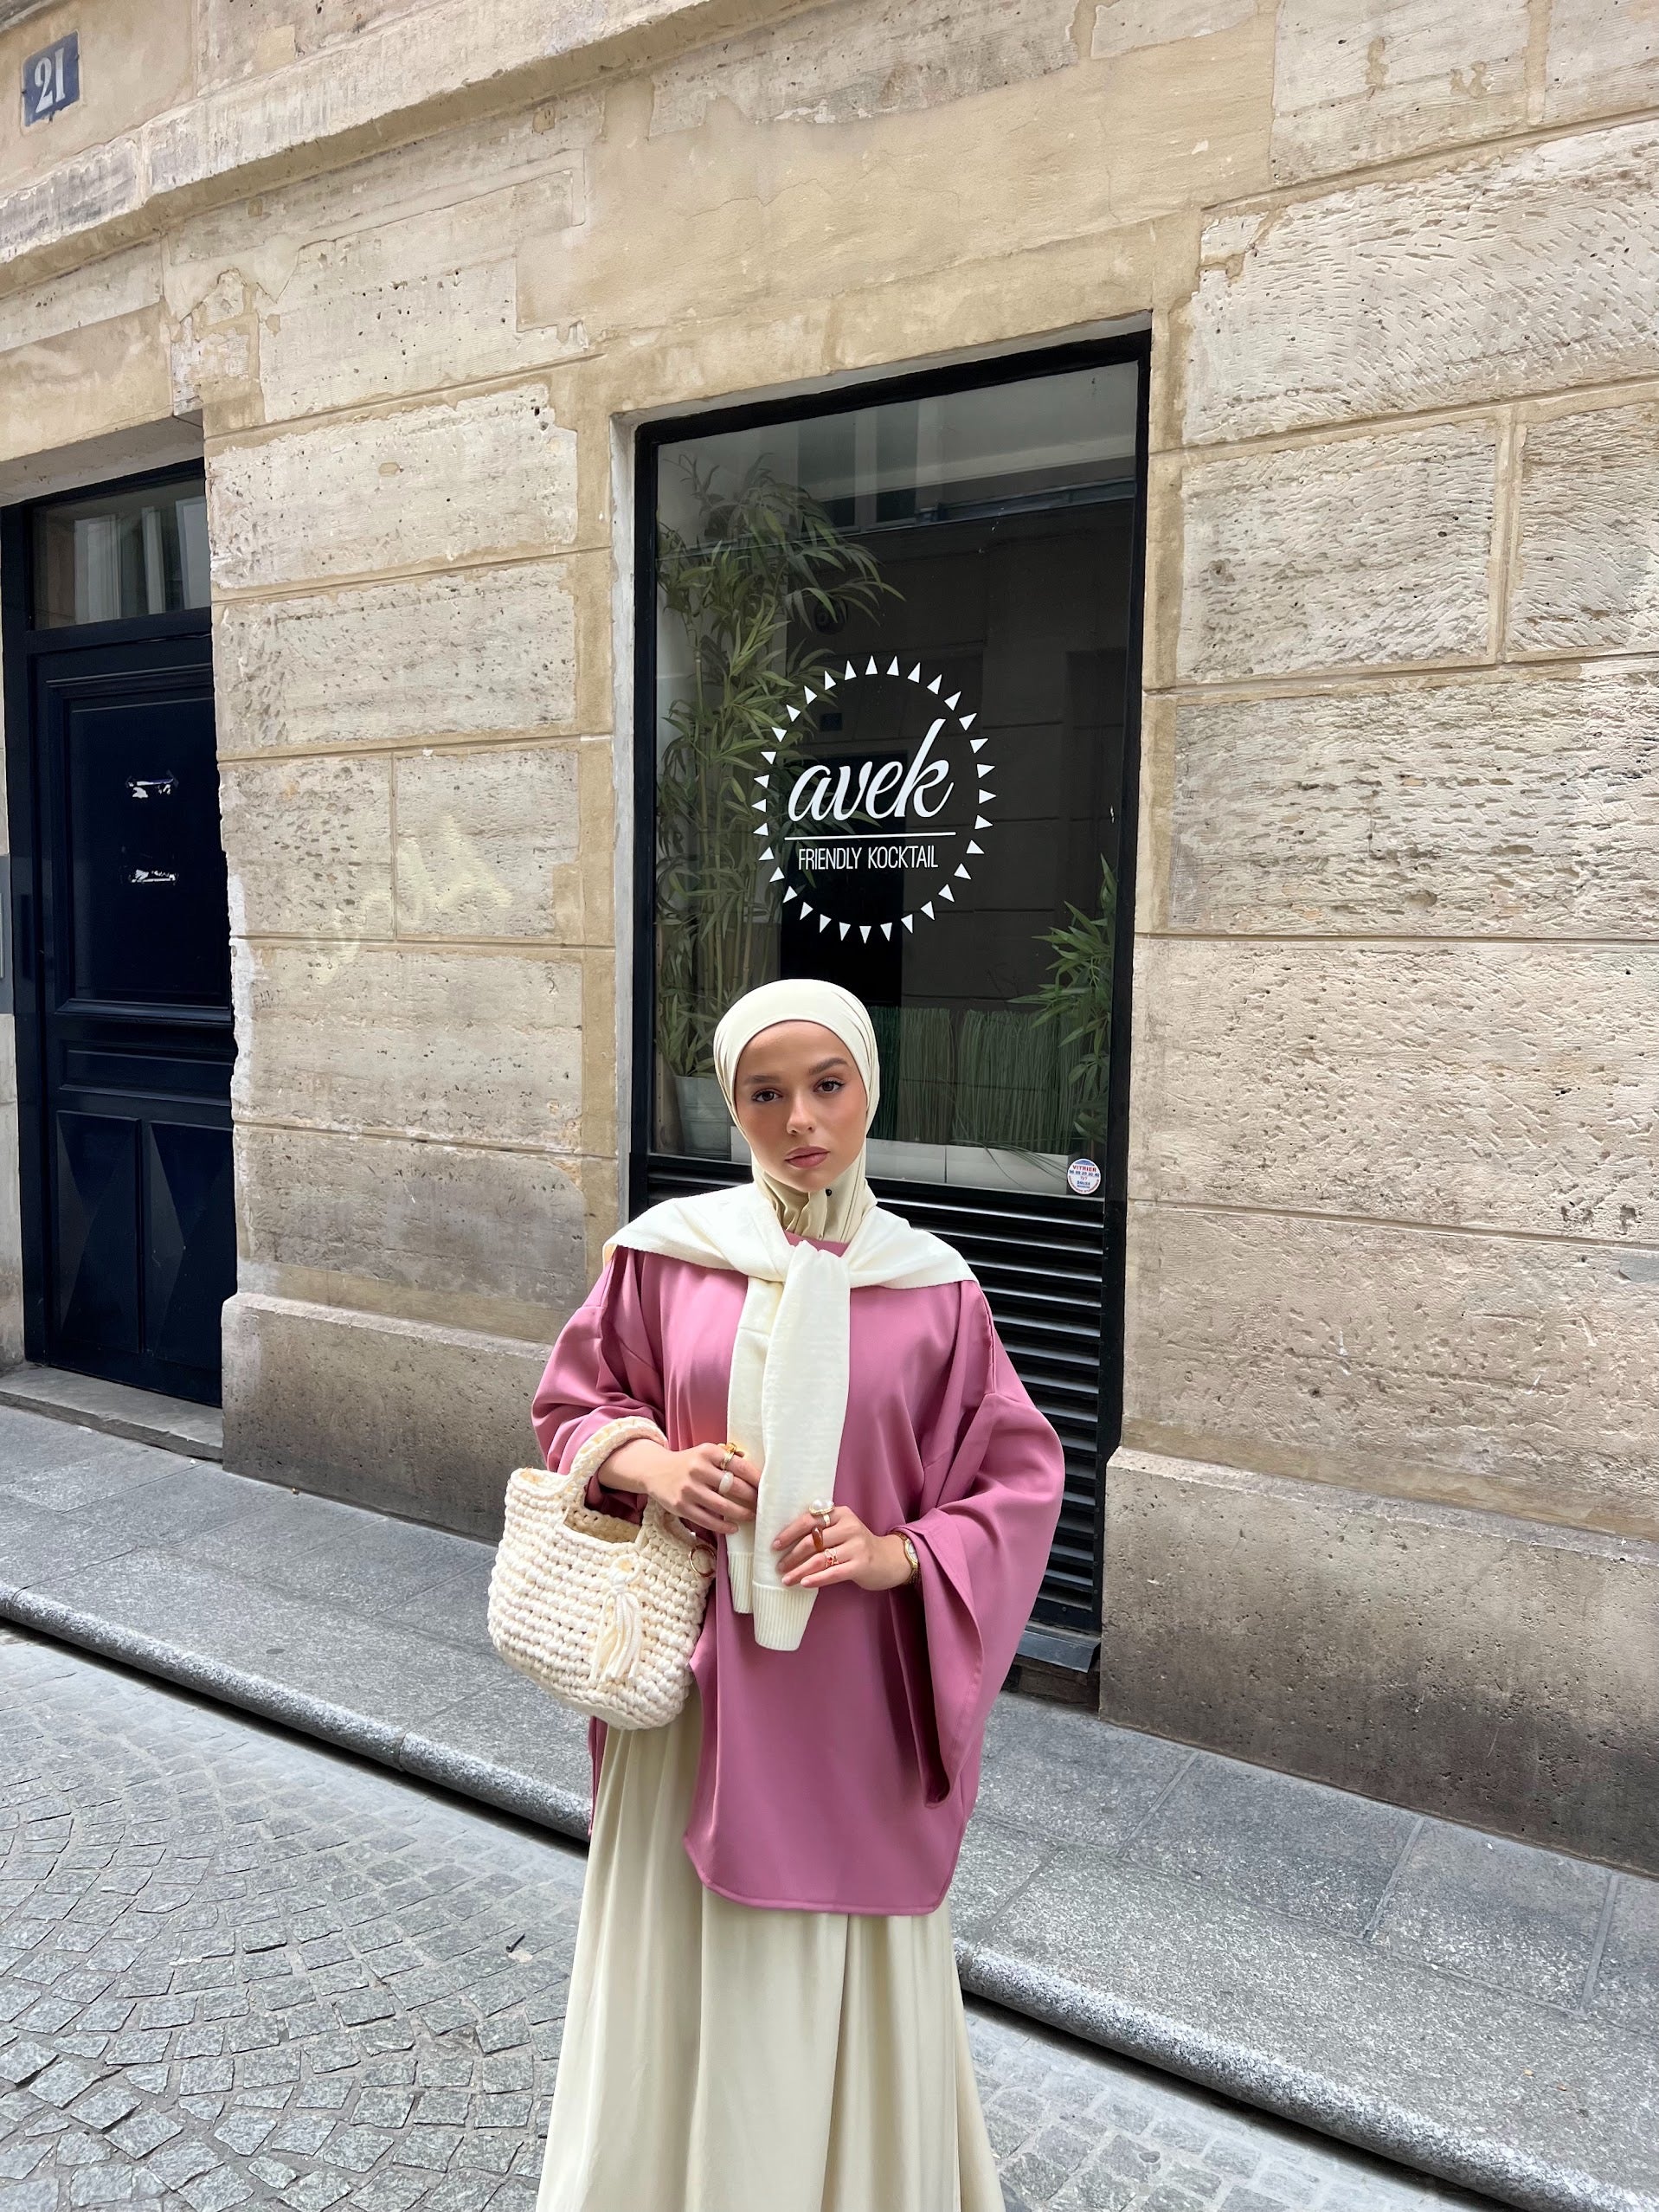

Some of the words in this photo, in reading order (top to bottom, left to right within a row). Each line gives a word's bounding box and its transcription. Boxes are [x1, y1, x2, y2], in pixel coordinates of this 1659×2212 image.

[35, 48, 66, 113] 21
[788, 718, 955, 822] avek
[798, 846, 863, 871] FRIENDLY
[868, 845, 939, 869] KOCKTAIL
